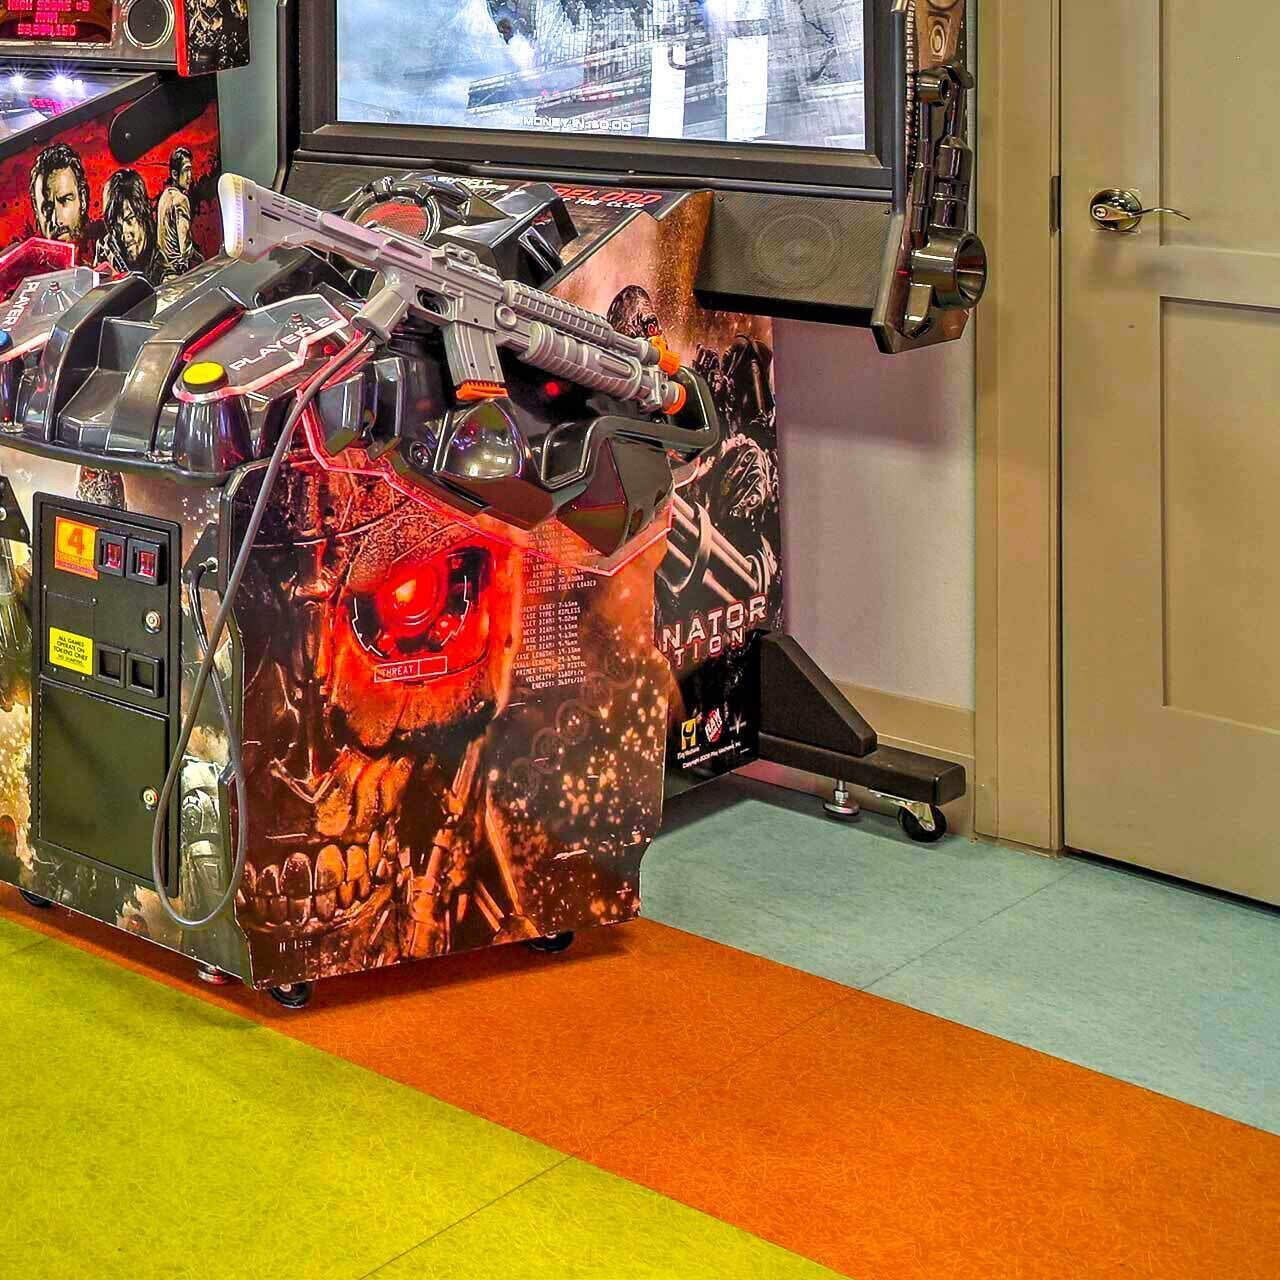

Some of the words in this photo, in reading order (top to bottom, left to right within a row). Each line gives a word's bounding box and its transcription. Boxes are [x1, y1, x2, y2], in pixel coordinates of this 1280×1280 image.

[228, 325, 316, 371] PLAYER
[67, 527, 85, 555] 4
[662, 593, 769, 654] NATOR
[382, 665, 414, 678] THREAT
